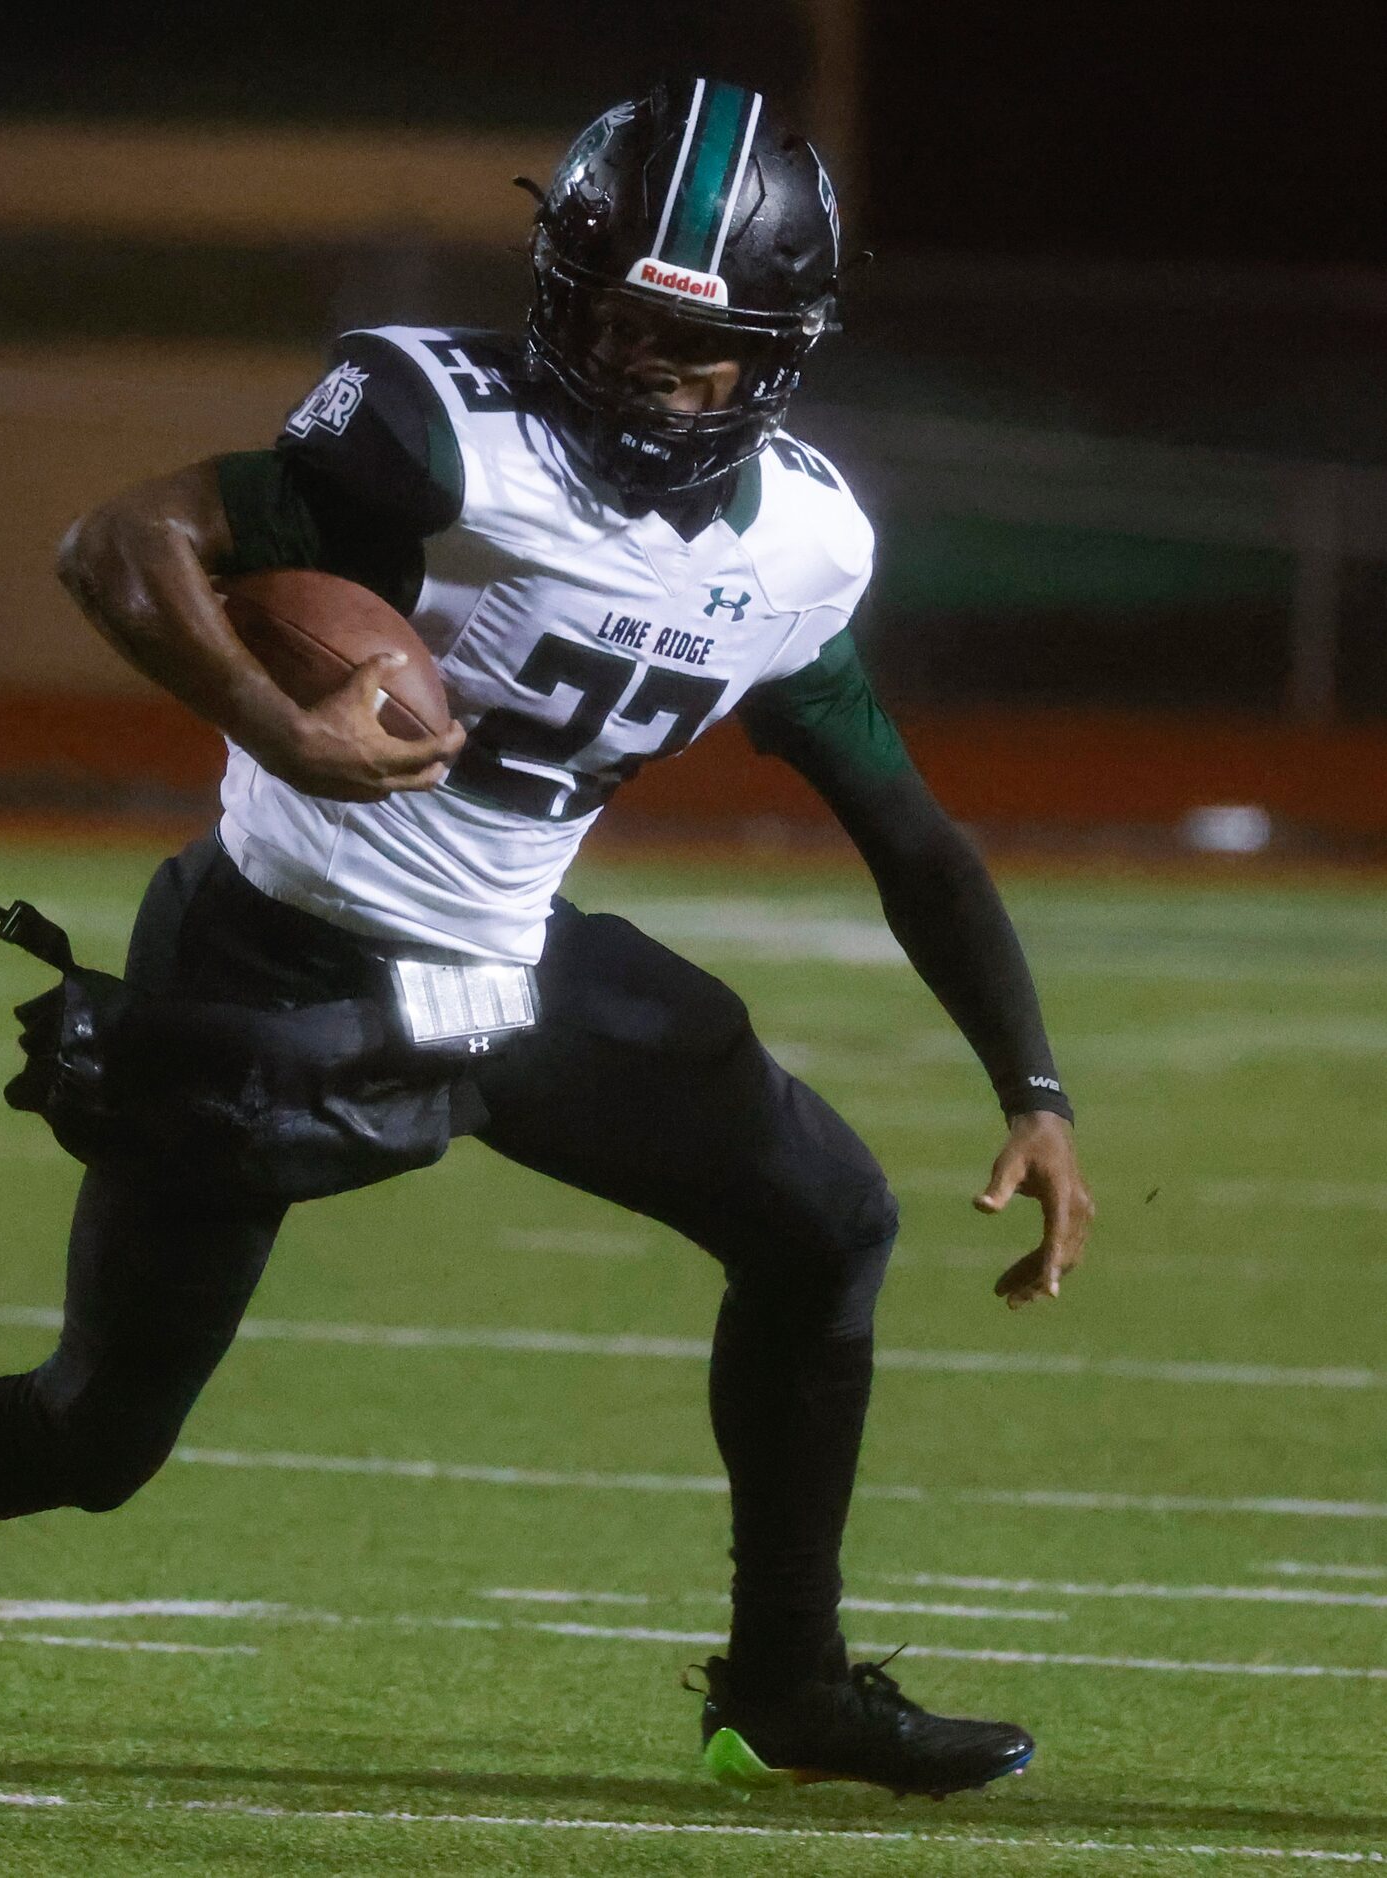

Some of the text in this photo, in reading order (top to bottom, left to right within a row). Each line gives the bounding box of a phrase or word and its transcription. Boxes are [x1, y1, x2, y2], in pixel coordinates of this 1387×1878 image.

[640, 264, 718, 298] Riddell
[596, 611, 715, 666] LAKE RIDGE
